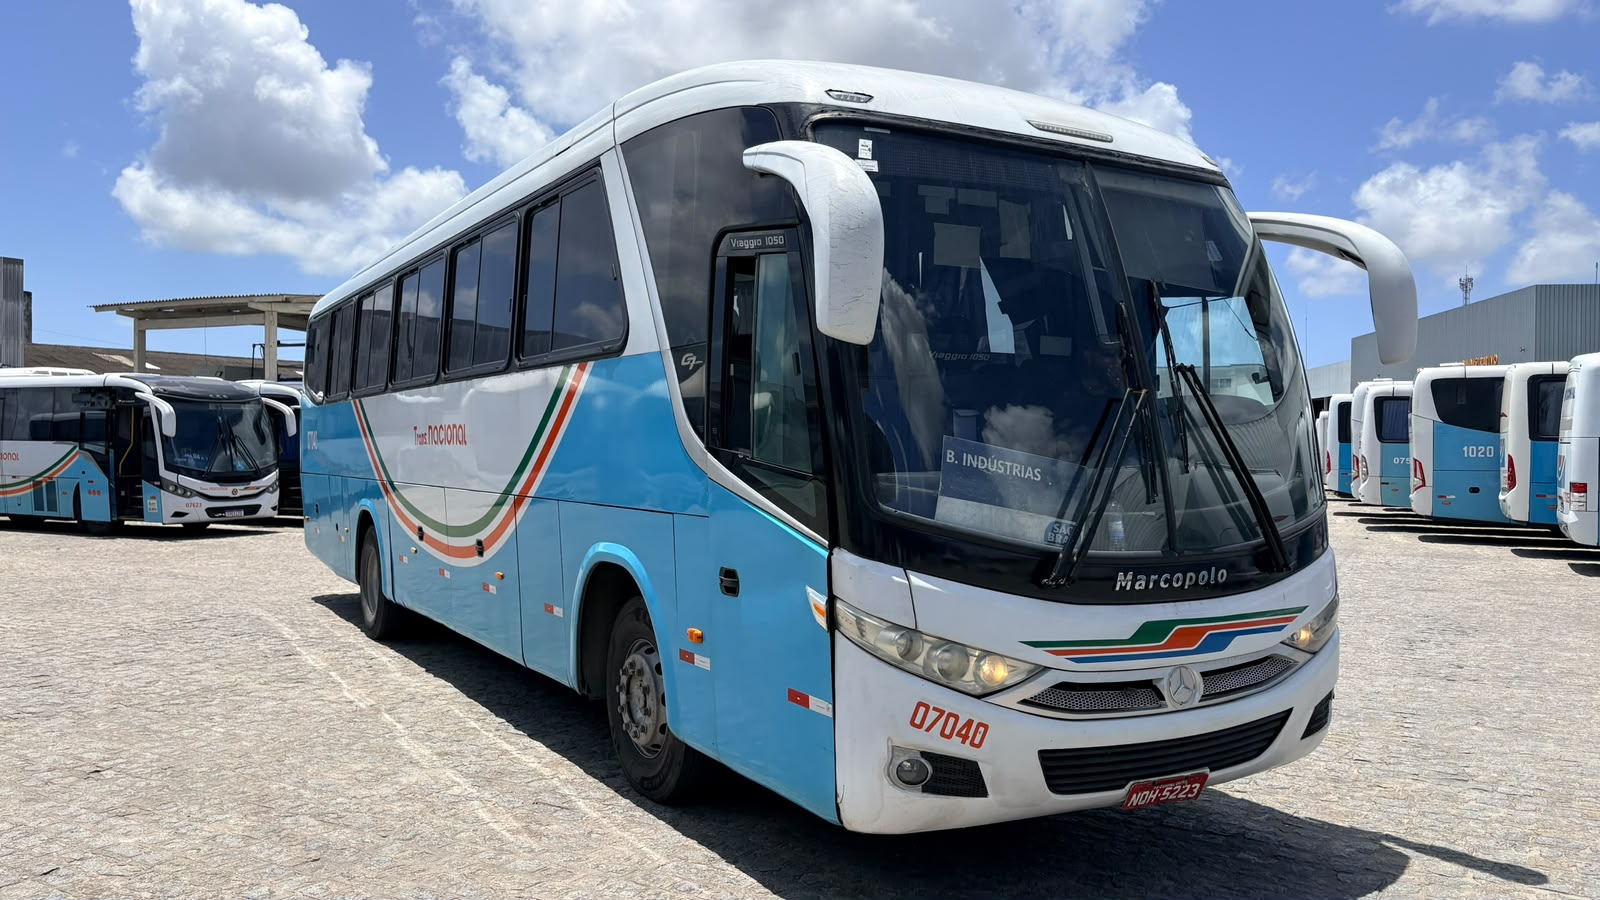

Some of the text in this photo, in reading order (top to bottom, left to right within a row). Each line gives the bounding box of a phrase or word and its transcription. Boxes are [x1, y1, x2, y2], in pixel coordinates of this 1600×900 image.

[730, 236, 785, 249] Viaggio 1050
[1463, 445, 1494, 458] 1020
[946, 449, 1042, 481] B. INDÚSTRIAS
[1115, 566, 1228, 591] Marcopolo
[909, 700, 990, 749] 07040
